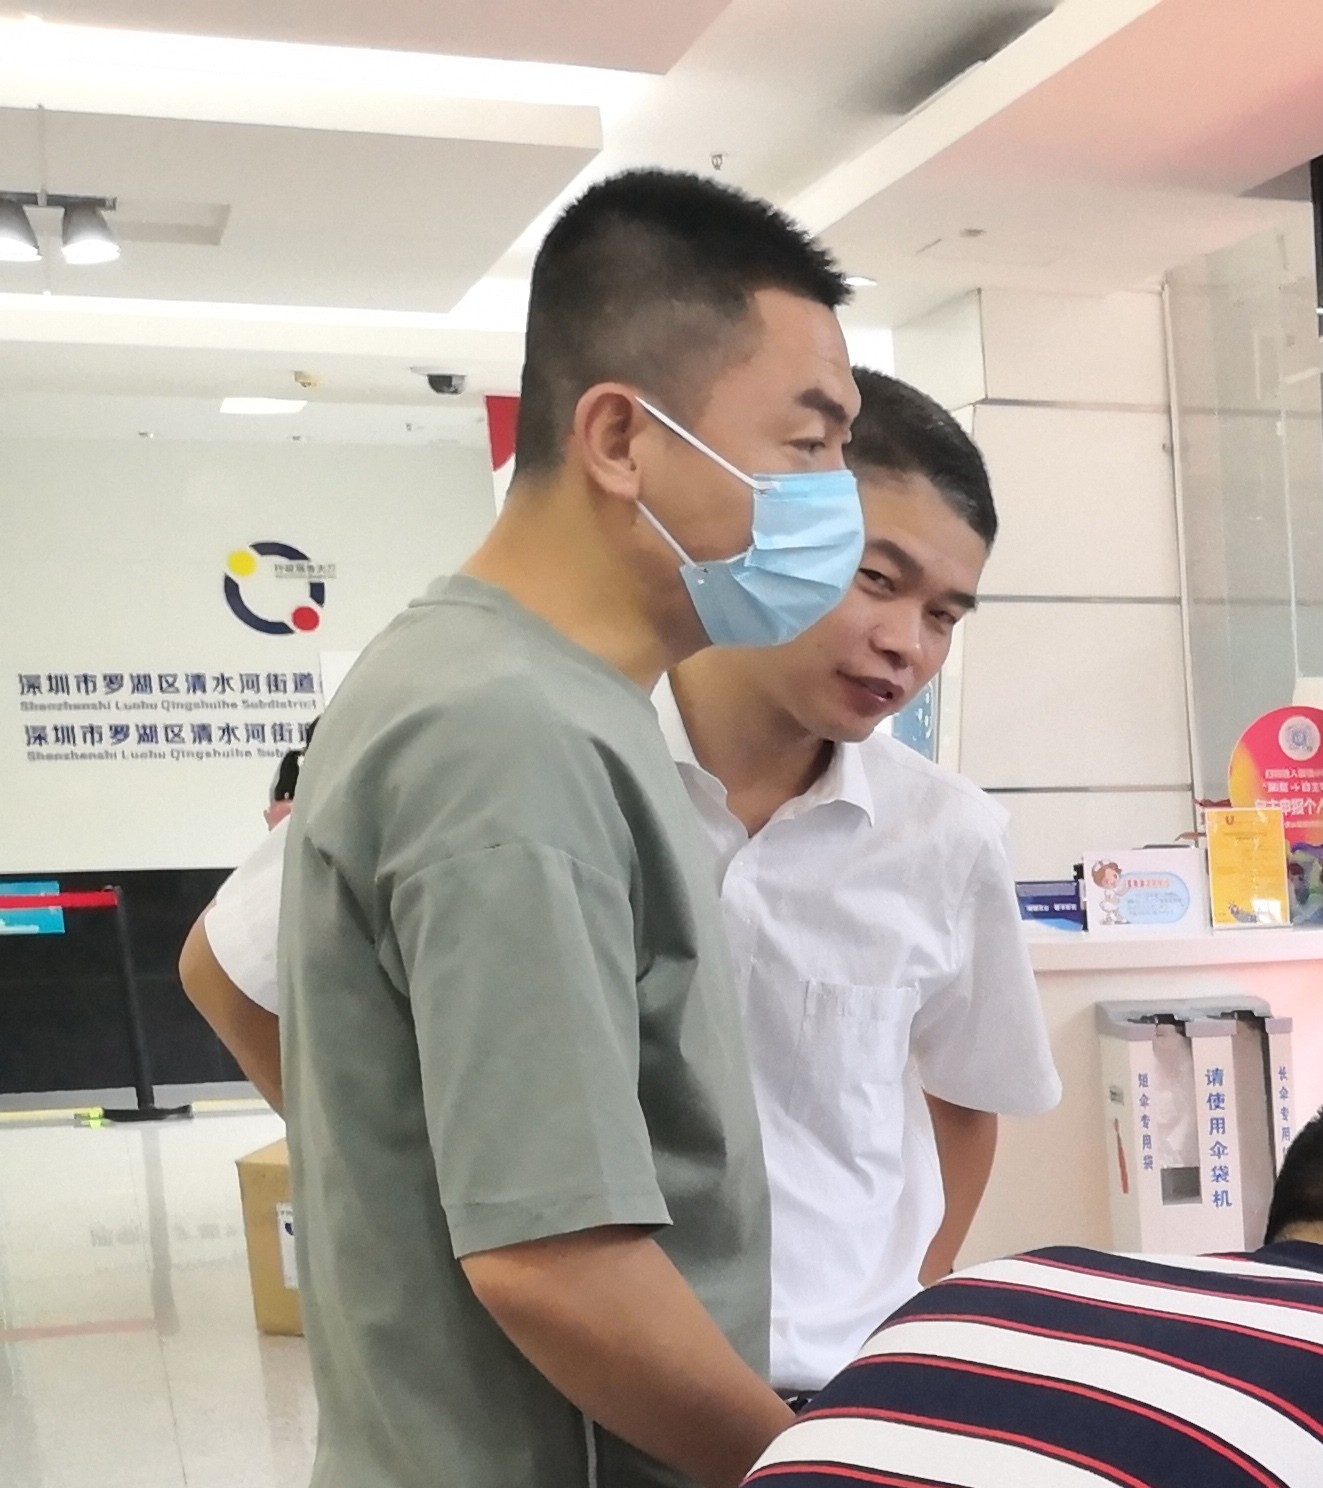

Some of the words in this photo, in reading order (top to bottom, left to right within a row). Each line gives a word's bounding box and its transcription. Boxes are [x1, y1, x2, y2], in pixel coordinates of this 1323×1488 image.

[115, 700, 158, 711] Luohu
[161, 700, 238, 713] Qingshuihe
[121, 750, 166, 761] Luohu
[170, 750, 251, 762] Qingshuihe
[1138, 1073, 1154, 1170] 短伞专用袋
[1205, 1067, 1232, 1208] 请使用伞袋机
[1278, 1066, 1291, 1156] 长伞专用
